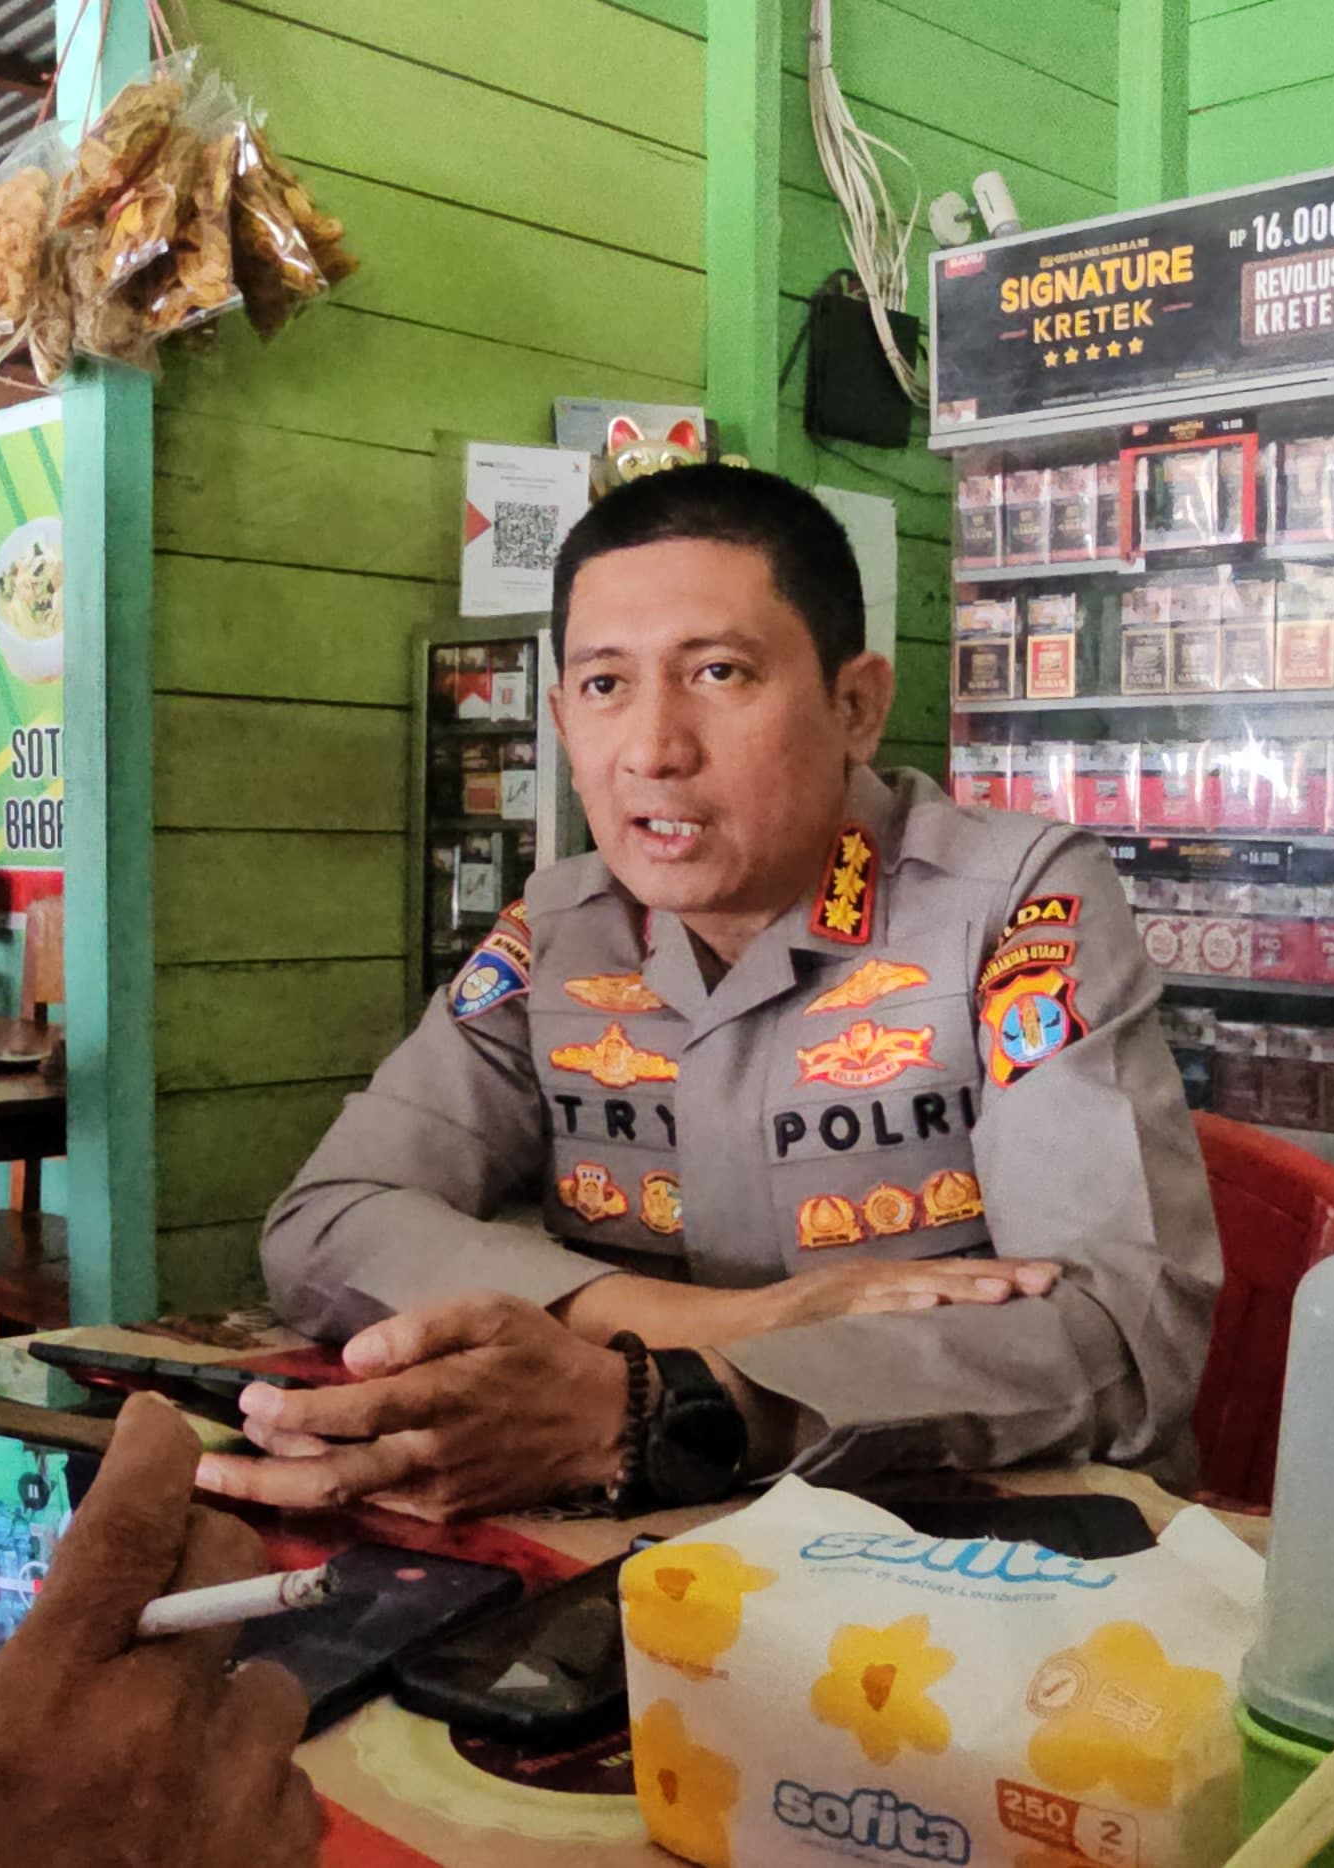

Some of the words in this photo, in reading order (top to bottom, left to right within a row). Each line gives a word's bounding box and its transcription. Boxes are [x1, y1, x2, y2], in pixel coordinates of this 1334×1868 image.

[1229, 229, 1248, 249] RP
[1000, 246, 1194, 314] SIGNATURE
[1034, 299, 1154, 343] KRETEK
[12, 728, 60, 778] SOT
[774, 1086, 977, 1158] POLRI
[774, 1780, 971, 1866] sofita
[1003, 1789, 1067, 1827] 250
[1101, 1821, 1122, 1846] 2
